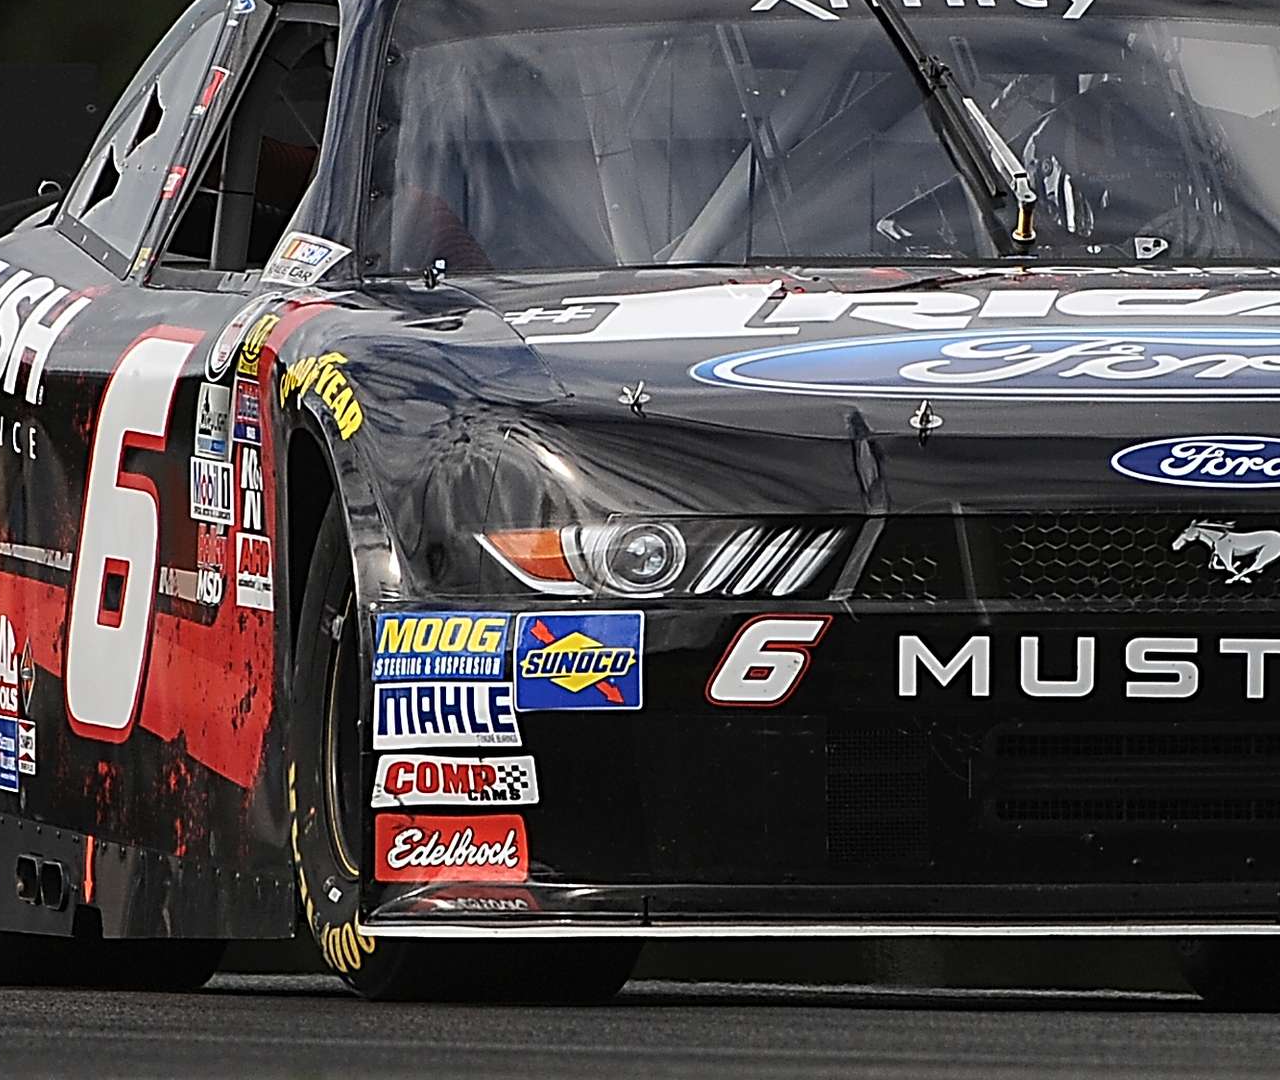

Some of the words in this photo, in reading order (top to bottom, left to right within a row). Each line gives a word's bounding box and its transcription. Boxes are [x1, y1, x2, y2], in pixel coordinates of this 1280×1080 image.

[64, 324, 206, 743] 6
[195, 570, 224, 608] MSD
[376, 617, 507, 655] MOOG
[374, 656, 422, 677] STEERING
[423, 657, 432, 676] &
[433, 656, 502, 677] SUSPENSION
[524, 649, 631, 675] SUNOCO
[704, 613, 835, 707] 6
[376, 686, 516, 737] MAHLE
[384, 761, 498, 796] COMP
[467, 787, 522, 802] CAMS
[387, 827, 519, 869] Edelbrock
